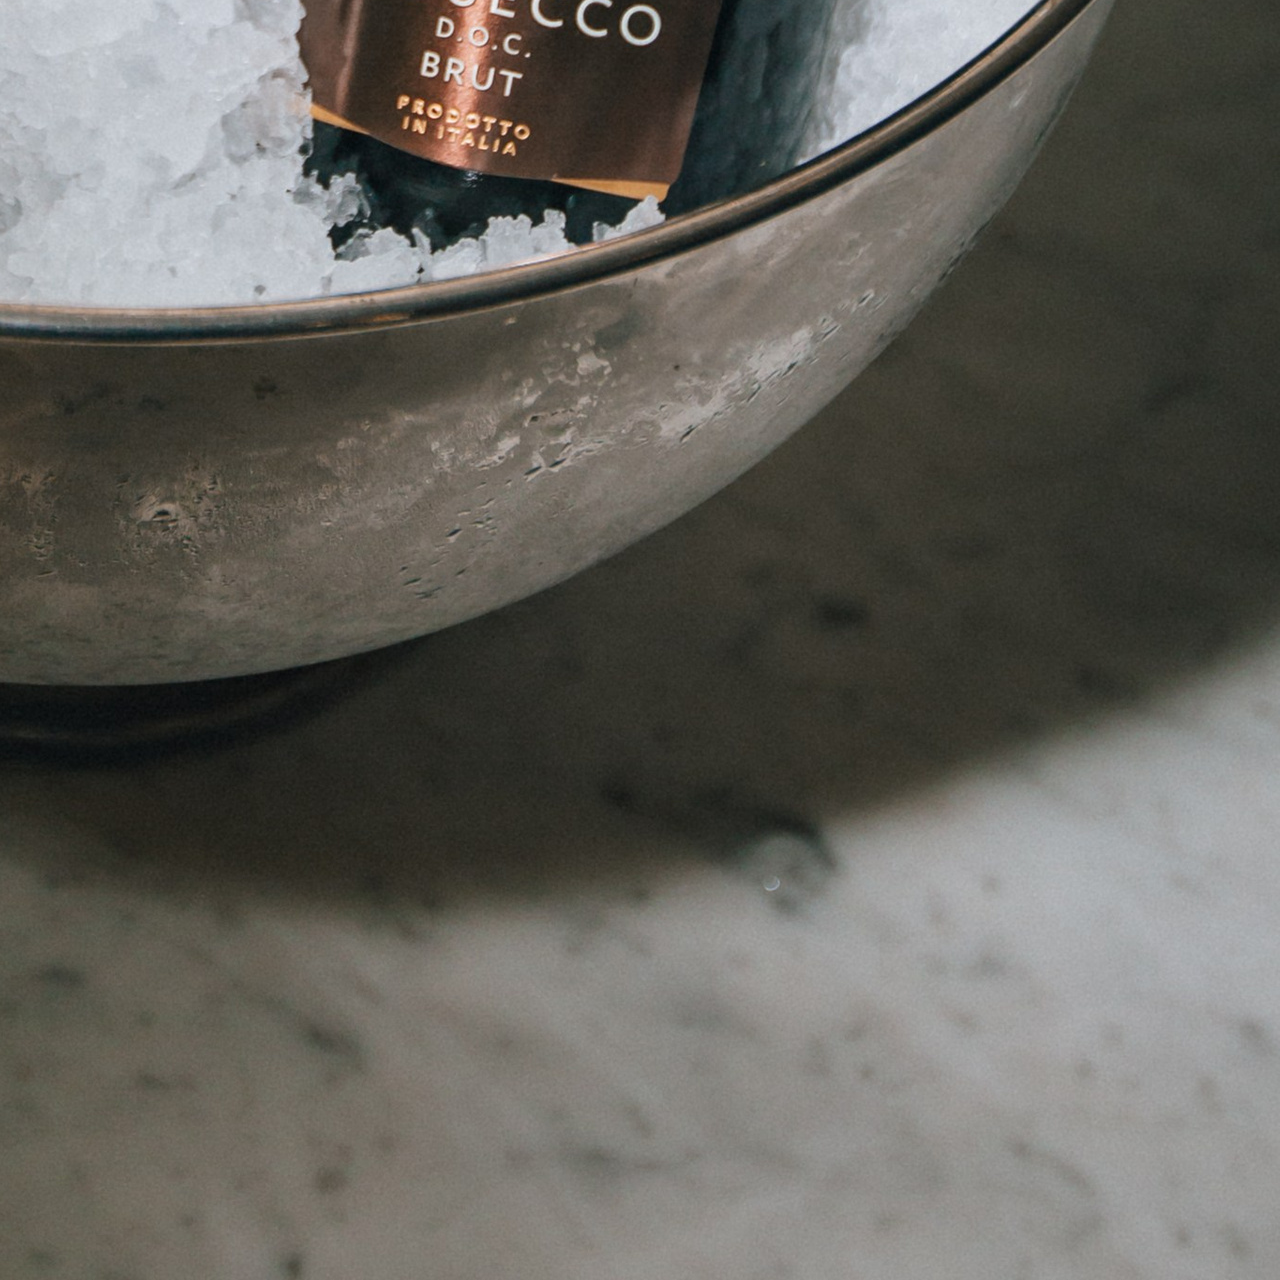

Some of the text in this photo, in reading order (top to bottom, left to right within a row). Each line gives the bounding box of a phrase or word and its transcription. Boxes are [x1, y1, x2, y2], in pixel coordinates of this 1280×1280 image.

[435, 16, 532, 58] D.O.C.
[420, 50, 524, 97] BRUT
[396, 94, 531, 140] PRODOTTO
[401, 116, 517, 157] IN ITALIA
